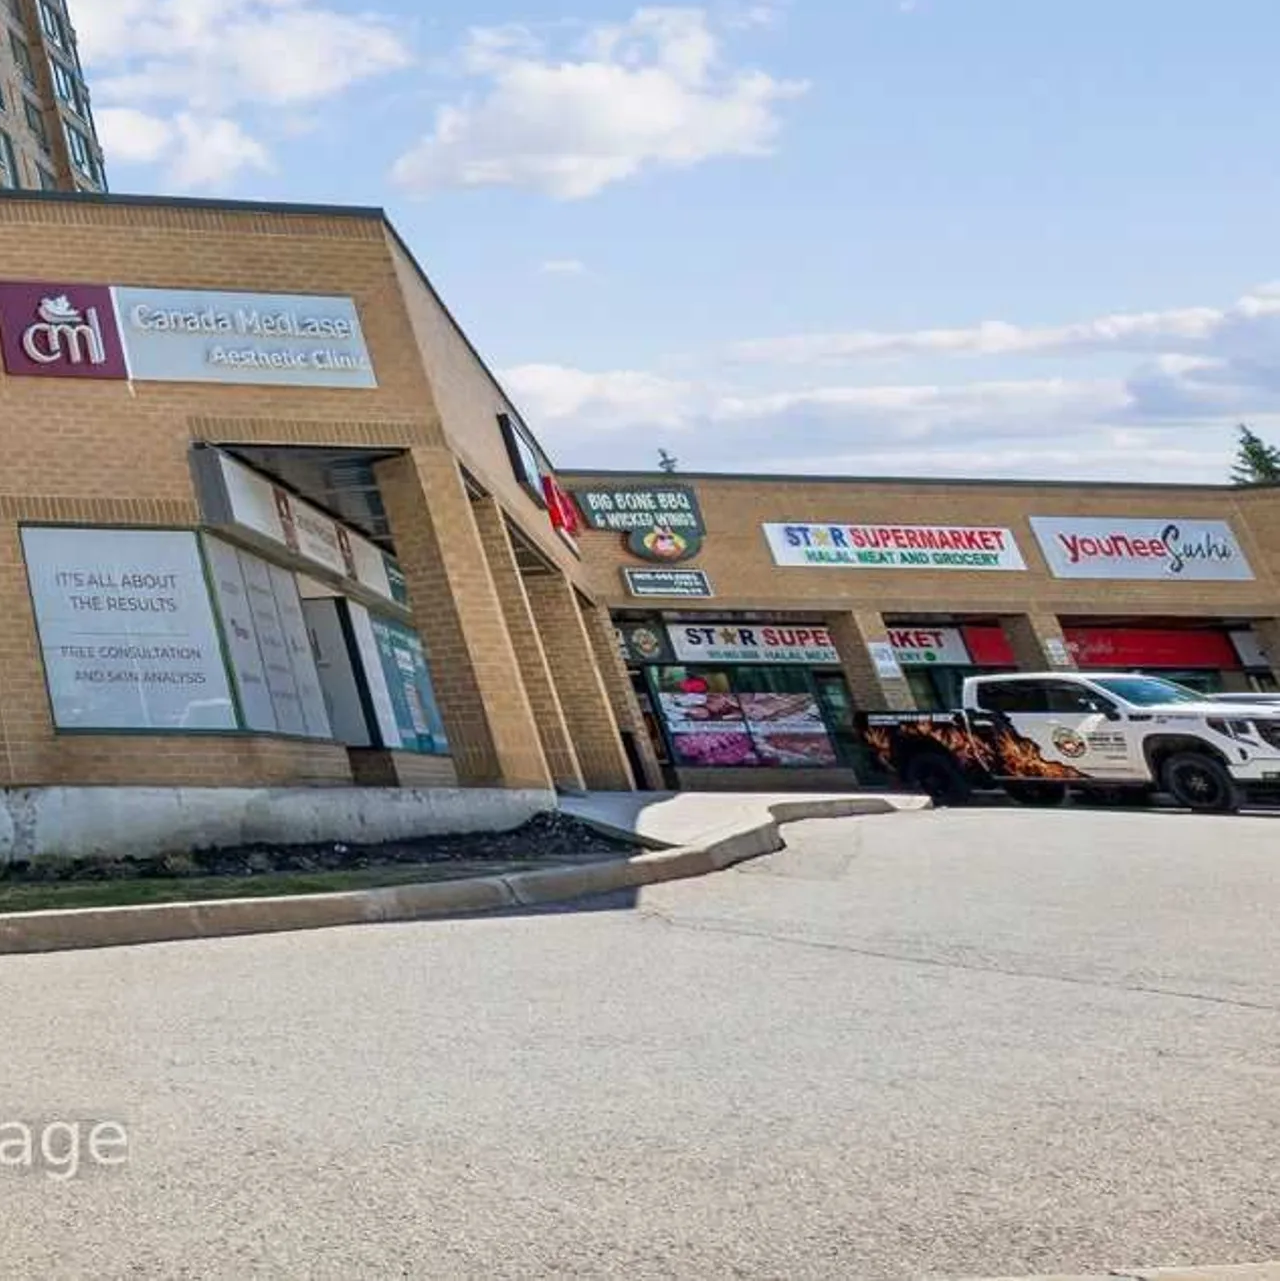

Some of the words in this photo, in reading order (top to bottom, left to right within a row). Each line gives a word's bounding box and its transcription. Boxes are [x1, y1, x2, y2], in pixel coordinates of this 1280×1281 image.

[131, 303, 233, 332] Canada
[209, 345, 307, 369] Aesthetic
[587, 493, 613, 510] BIG
[614, 493, 657, 510] BONE
[657, 493, 692, 510] BBQ
[606, 512, 654, 526] WICKED
[850, 528, 1006, 551] SUPERMARKET
[805, 549, 856, 564] HALAL
[857, 550, 897, 565] MEAT
[900, 552, 932, 566] AND
[933, 552, 1000, 567] GROCERY
[55, 572, 85, 587] IT'S
[87, 573, 119, 588] ALL
[121, 573, 178, 589] ABOUT
[69, 596, 104, 611] THE
[106, 597, 178, 612] RESULTS
[60, 646, 95, 659] FREE
[98, 646, 203, 660] CONSULTATION
[143, 670, 207, 684] ANALYSIS
